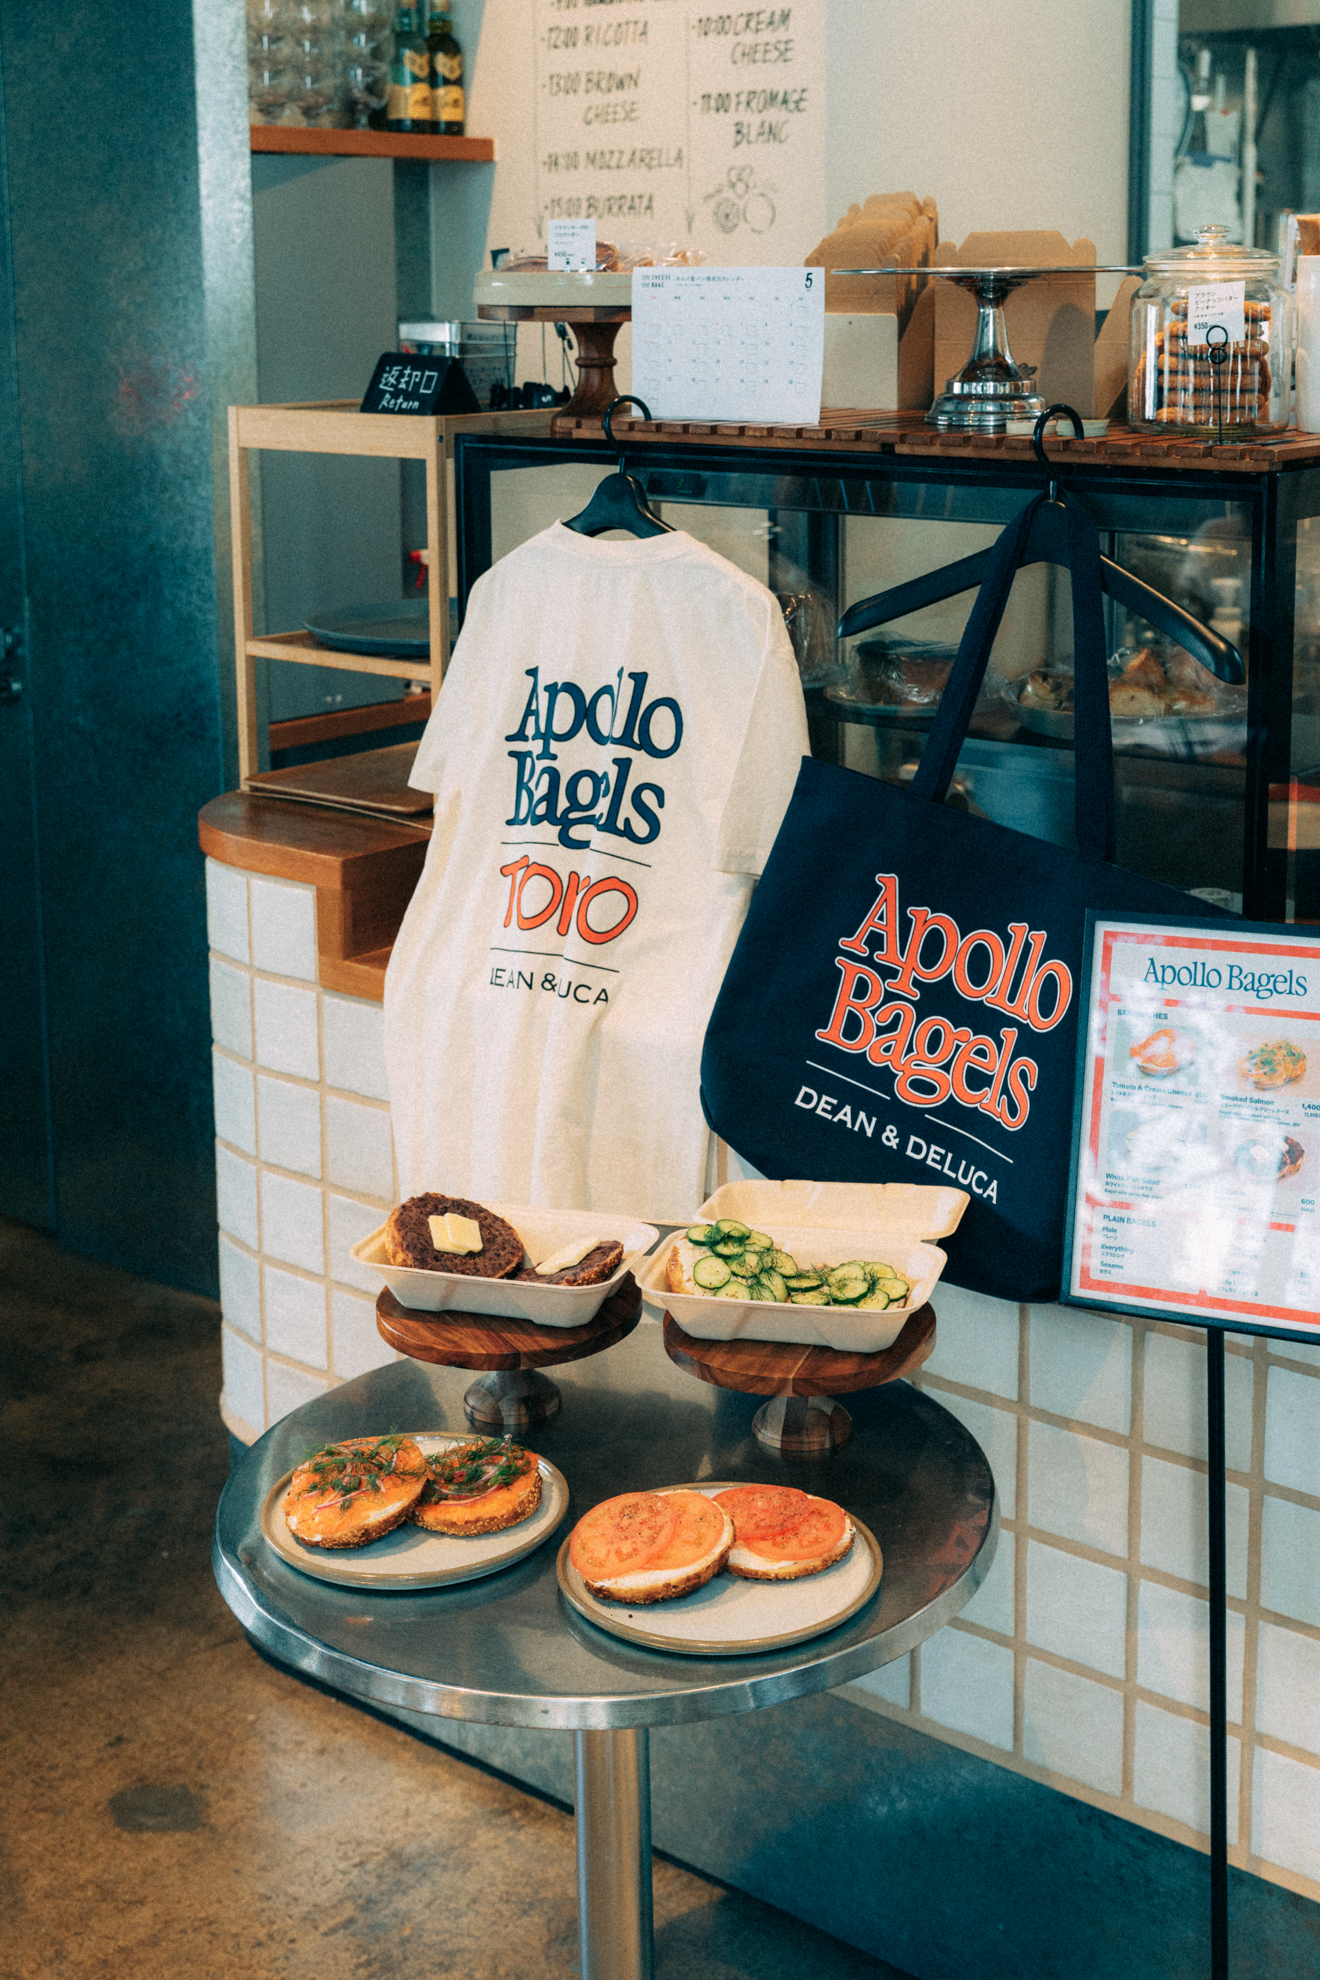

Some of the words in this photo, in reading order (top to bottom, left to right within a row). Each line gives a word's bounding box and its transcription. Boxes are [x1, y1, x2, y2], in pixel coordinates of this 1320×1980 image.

[733, 7, 792, 35] CREAM
[730, 39, 794, 64] CHEESE
[584, 68, 640, 94] BROWN
[584, 101, 640, 126] CHEESE
[734, 88, 808, 114] FROMAGE
[733, 119, 789, 148] BLANC
[584, 148, 683, 171] MOZZARELLA
[586, 194, 654, 219] BURRATA
[804, 272, 813, 288] 5
[379, 366, 438, 393] 返却口
[378, 392, 420, 411] Return
[838, 873, 1072, 1032] Apollo
[1143, 958, 1222, 991] Apollo
[1225, 964, 1308, 999] Bagels
[815, 956, 1038, 1131] Bagels
[1112, 1082, 1136, 1090] Tomato
[1144, 1085, 1166, 1094] Cream
[1167, 1088, 1192, 1096] Cheese
[1220, 1094, 1248, 1102] Smoked
[1249, 1097, 1274, 1106] Salmon
[794, 1086, 877, 1138] DEAN
[882, 1124, 900, 1149] &
[906, 1134, 998, 1204] DELUCA
[1106, 1172, 1124, 1180] White
[1142, 1177, 1160, 1185] Salad
[1103, 1214, 1125, 1223] PLAIN
[1126, 1217, 1156, 1227] BAGELS
[1101, 1244, 1134, 1254] Everything
[1100, 1261, 1124, 1269] Sesame
